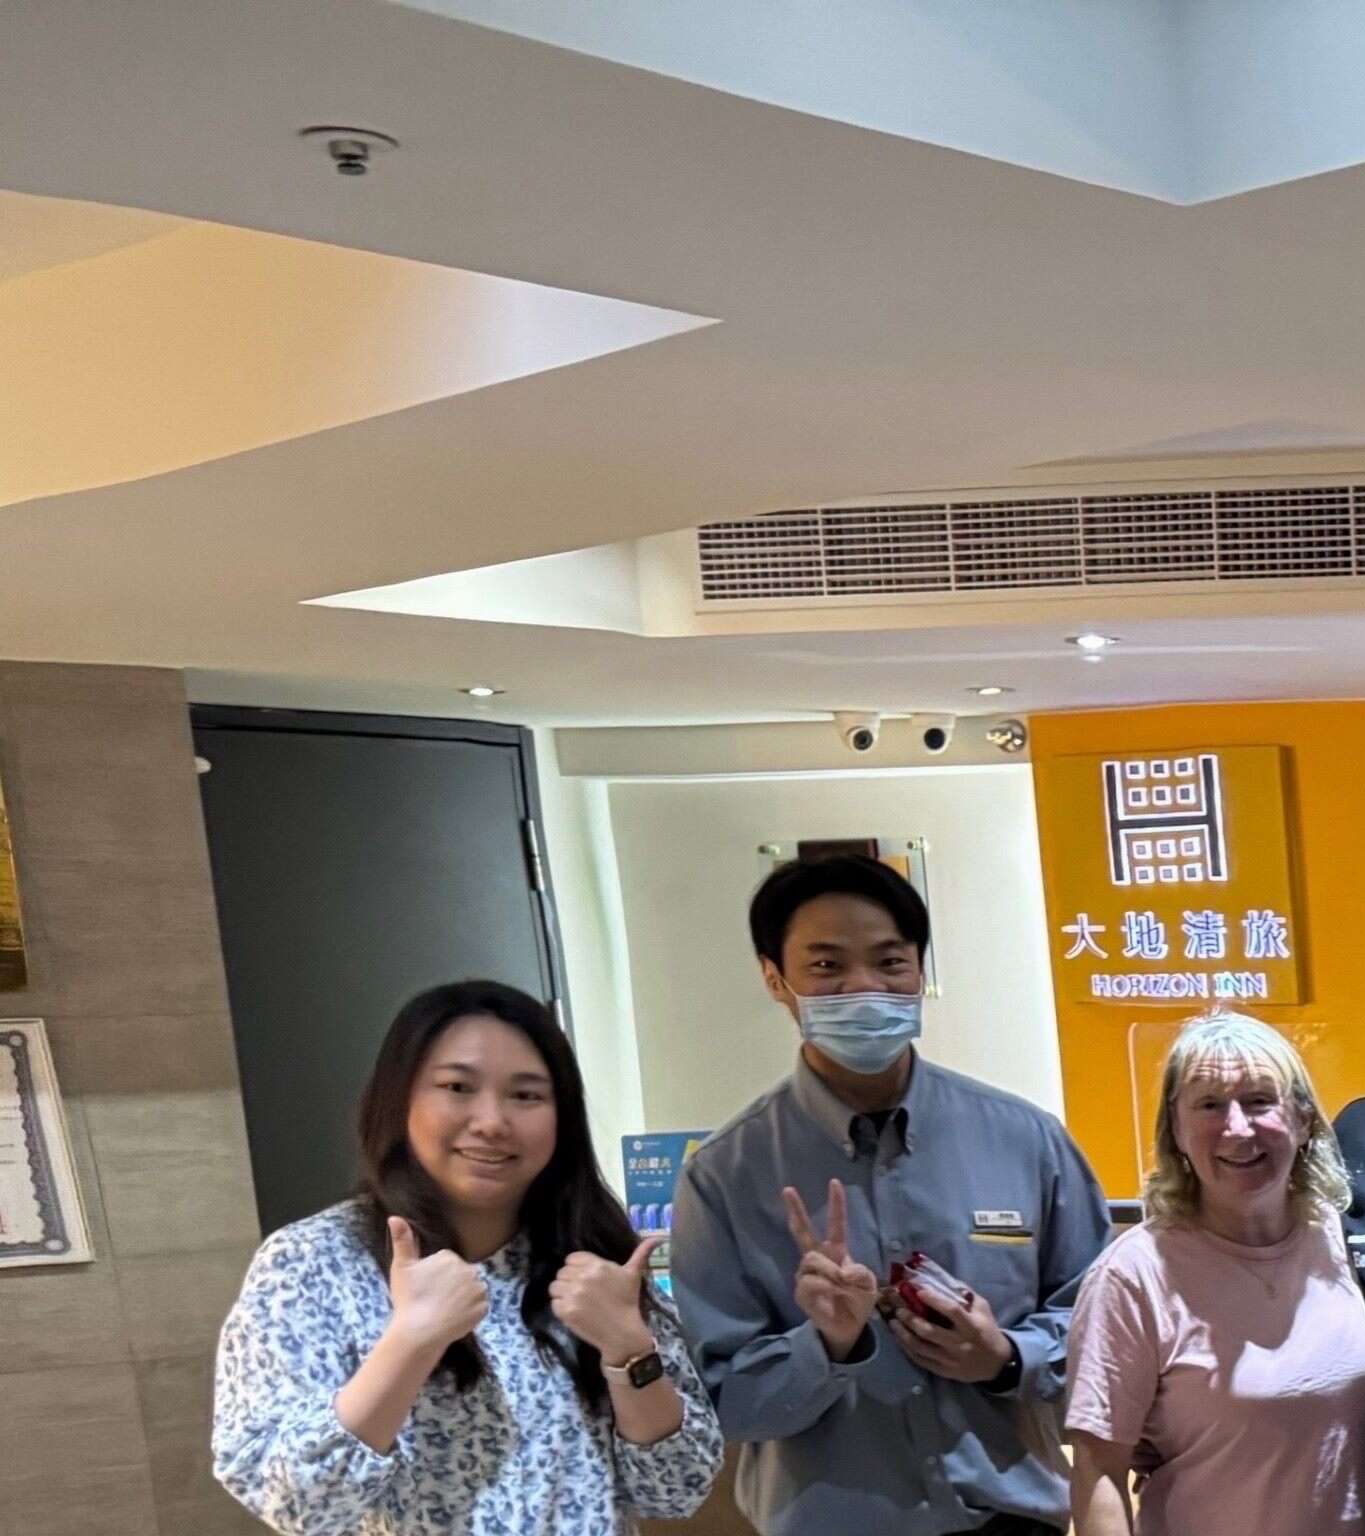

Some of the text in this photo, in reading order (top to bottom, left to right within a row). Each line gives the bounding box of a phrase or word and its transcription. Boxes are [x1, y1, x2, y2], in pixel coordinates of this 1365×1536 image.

[1060, 909, 1291, 960] 大地清旅
[1091, 971, 1268, 998] HORIZON INN
